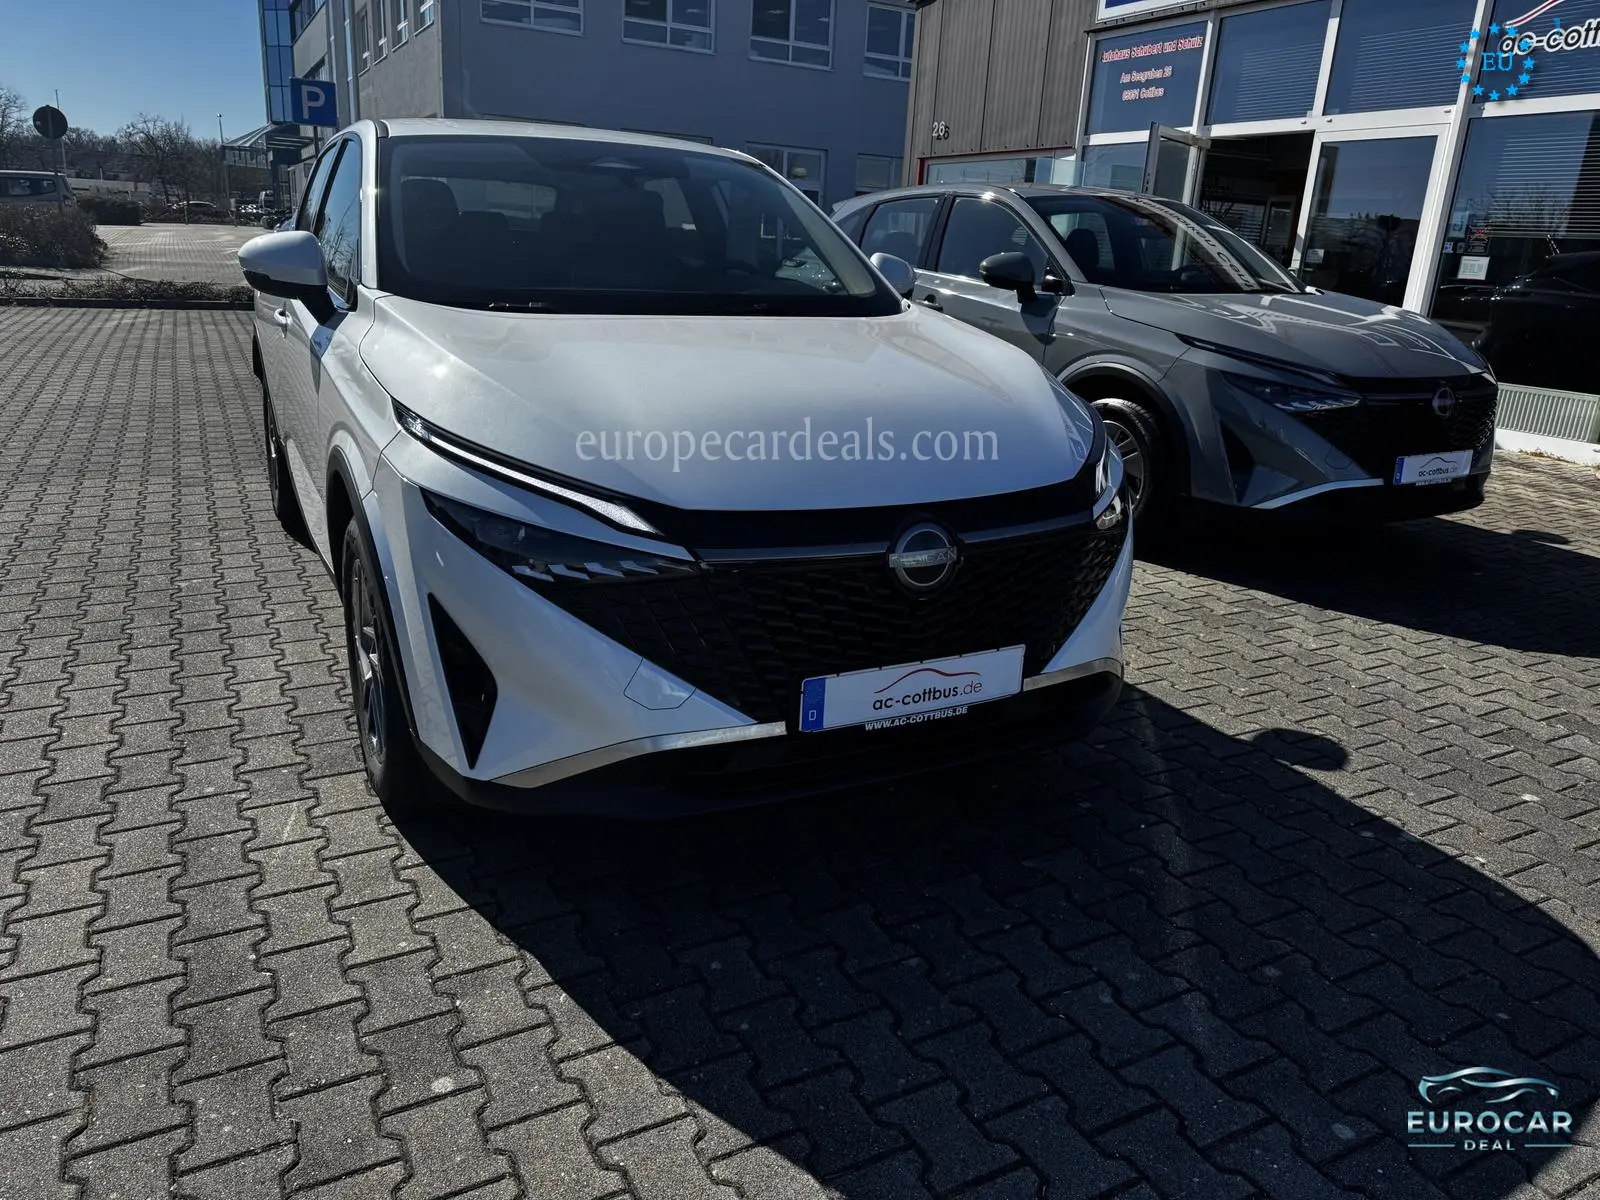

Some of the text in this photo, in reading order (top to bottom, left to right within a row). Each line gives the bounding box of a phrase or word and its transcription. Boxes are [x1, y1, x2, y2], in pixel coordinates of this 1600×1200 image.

[1131, 43, 1162, 58] Schubert
[1163, 41, 1177, 53] und
[301, 85, 326, 119] P
[932, 121, 945, 137] 26
[891, 546, 957, 567] NSAN
[872, 681, 983, 711] ac-cottbus.de
[809, 710, 816, 721] D
[865, 706, 968, 731] WWW.AC-COTTBUS.DE
